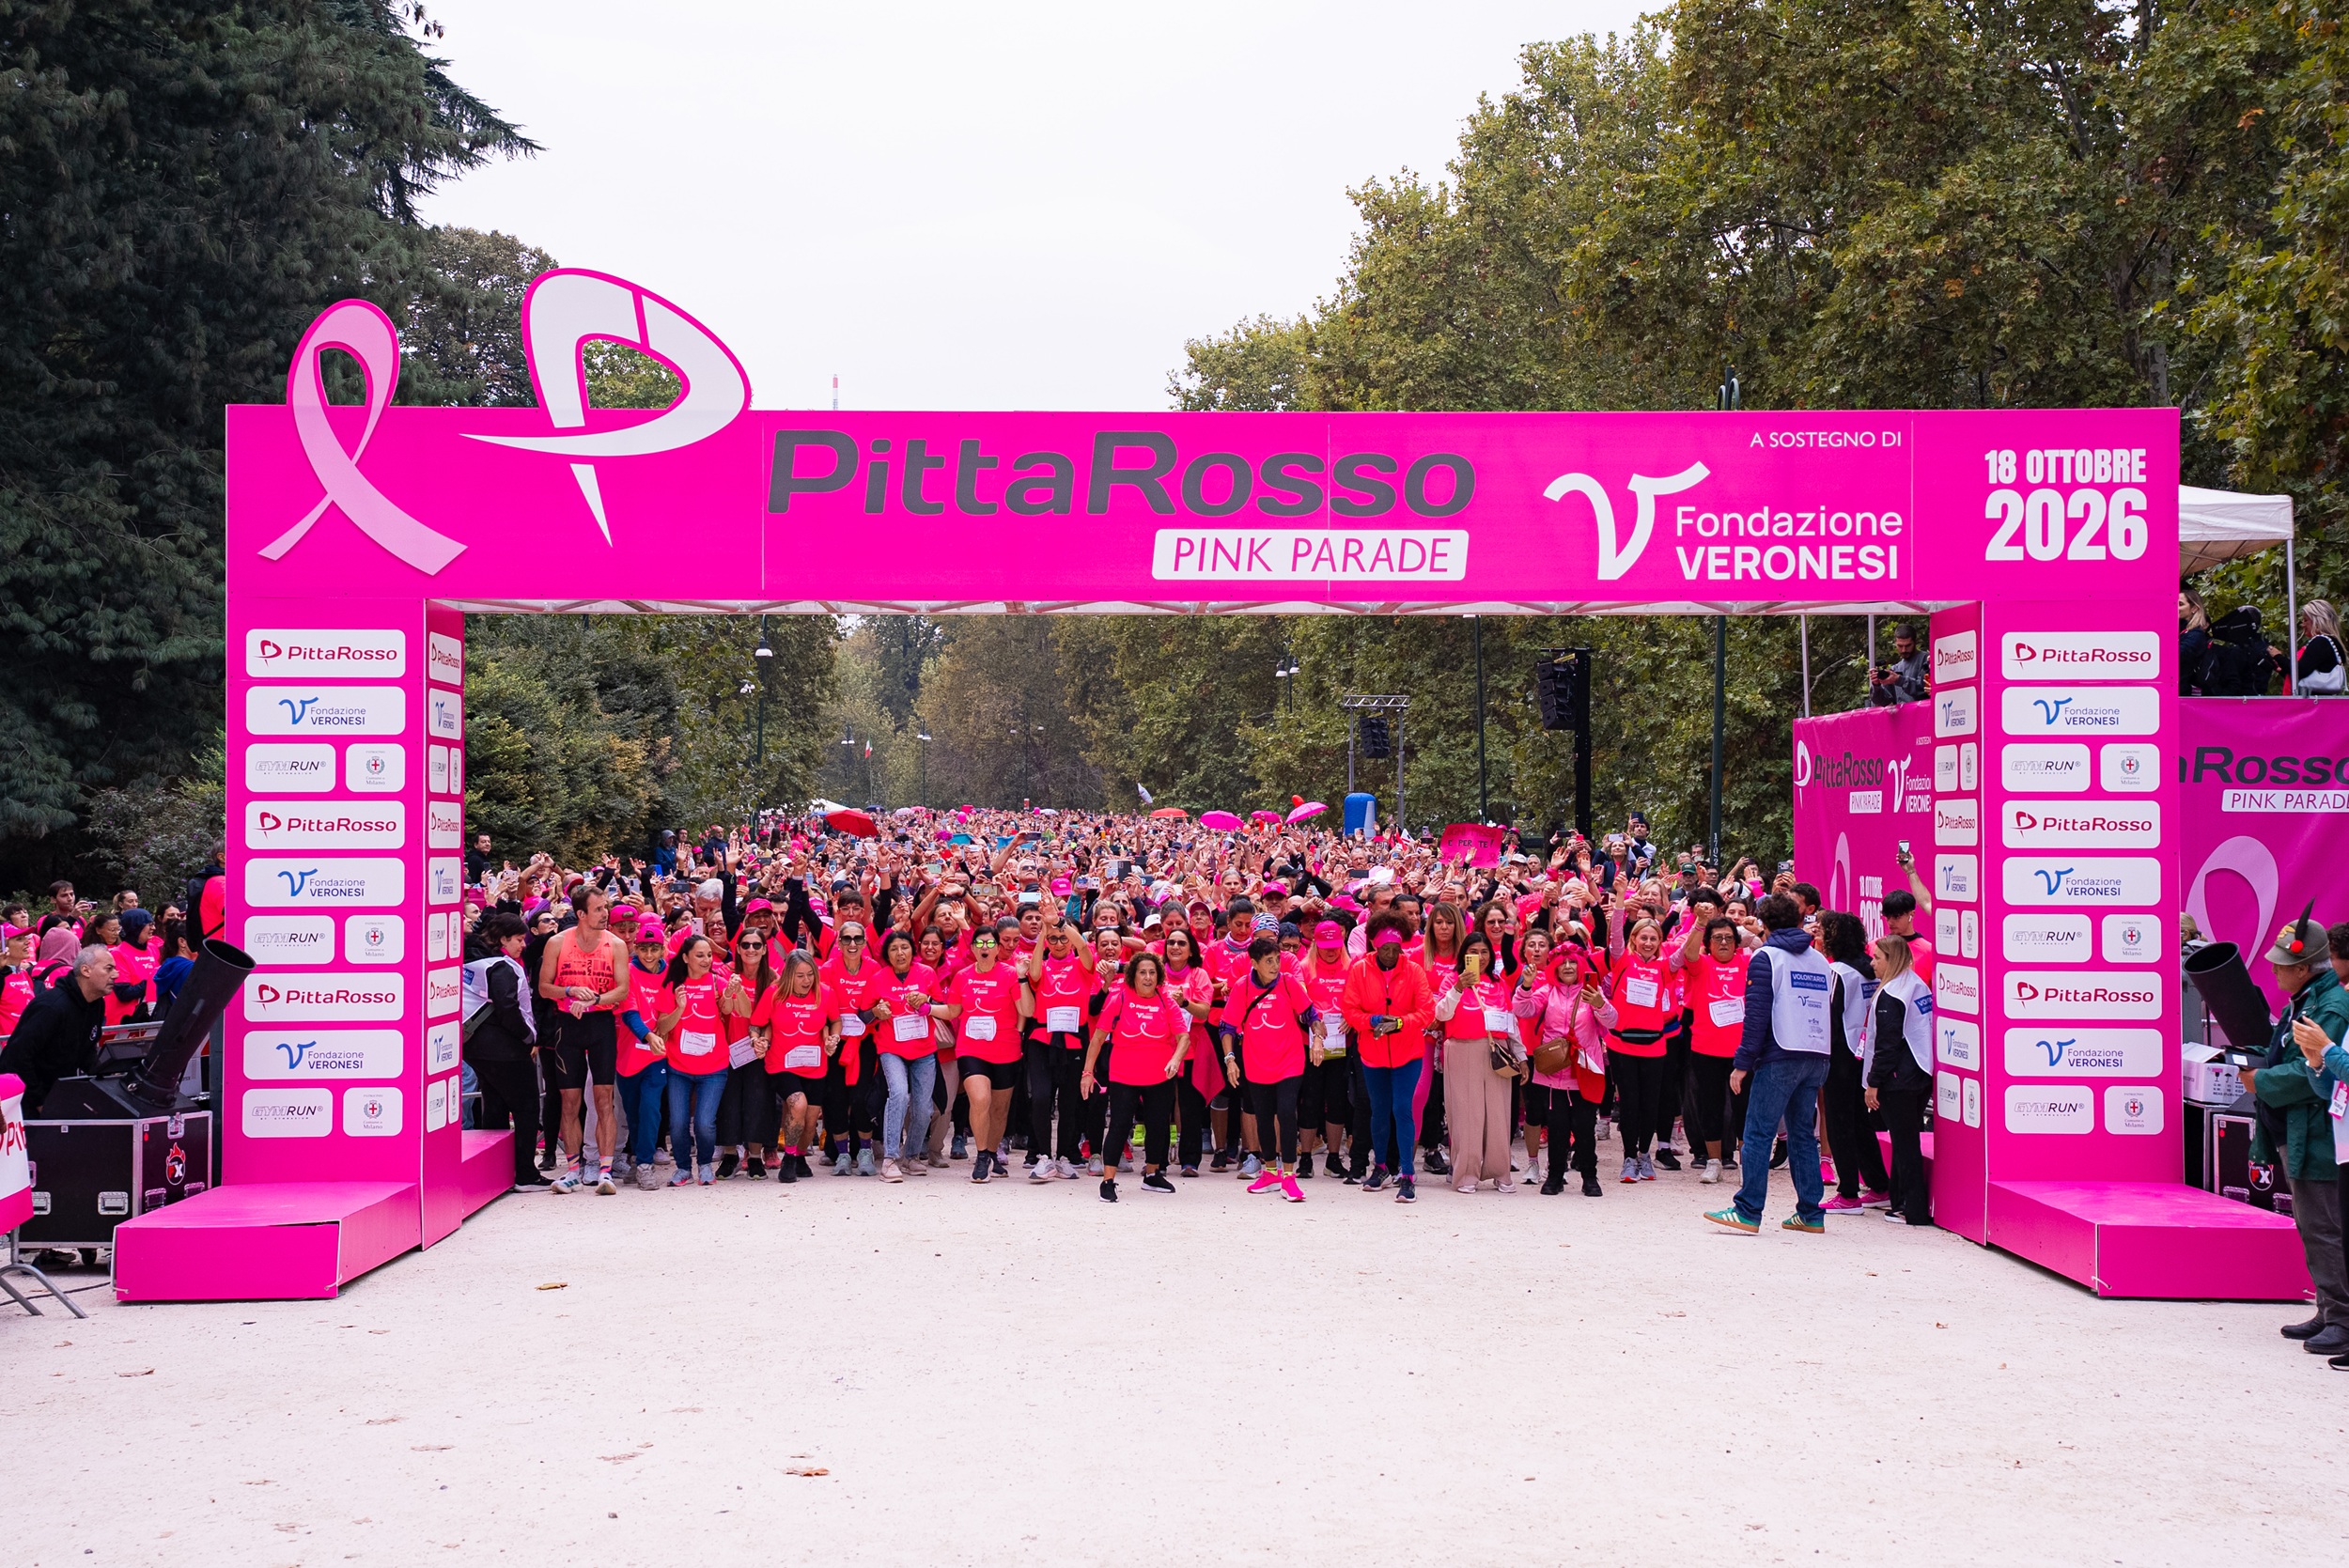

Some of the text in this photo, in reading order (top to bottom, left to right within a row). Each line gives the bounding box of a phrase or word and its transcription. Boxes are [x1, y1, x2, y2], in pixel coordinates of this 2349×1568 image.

[1750, 431, 1901, 447] A SOSTEGNO DI
[767, 429, 1476, 516] PittaRosso
[1984, 448, 2147, 484] 18 OTTOBRE
[1676, 505, 1903, 536] Fondazione
[1984, 488, 2148, 562] 2026
[1174, 536, 1452, 574] PINK PARADE
[1675, 545, 1898, 581] VERONESI
[288, 646, 397, 660] PittaRosso
[1944, 649, 1974, 666] PittaRosso
[2043, 649, 2151, 662] PittaRosso
[311, 717, 365, 725] VERONESI
[2065, 717, 2119, 725] VERONESI
[1813, 752, 1884, 788] PittaRosso
[2232, 793, 2276, 809] PINK
[288, 818, 397, 831] PittaRosso
[1945, 815, 1976, 830] PittaRosso
[2044, 817, 2152, 831] PittaRosso
[310, 888, 364, 896] VERONESI
[2066, 887, 2120, 895] VERONESI
[1792, 973, 1826, 983] VOLONTARIO
[1946, 980, 1977, 998] PittaRosso
[2045, 988, 2154, 1002] PittaRosso
[286, 990, 396, 1003] PittaRosso
[2068, 1048, 2123, 1057] Fondazione
[308, 1061, 362, 1069] VERONESI
[2068, 1059, 2122, 1067] VERONESI
[168, 1164, 183, 1178] FX
[2251, 1170, 2271, 1184] FX
